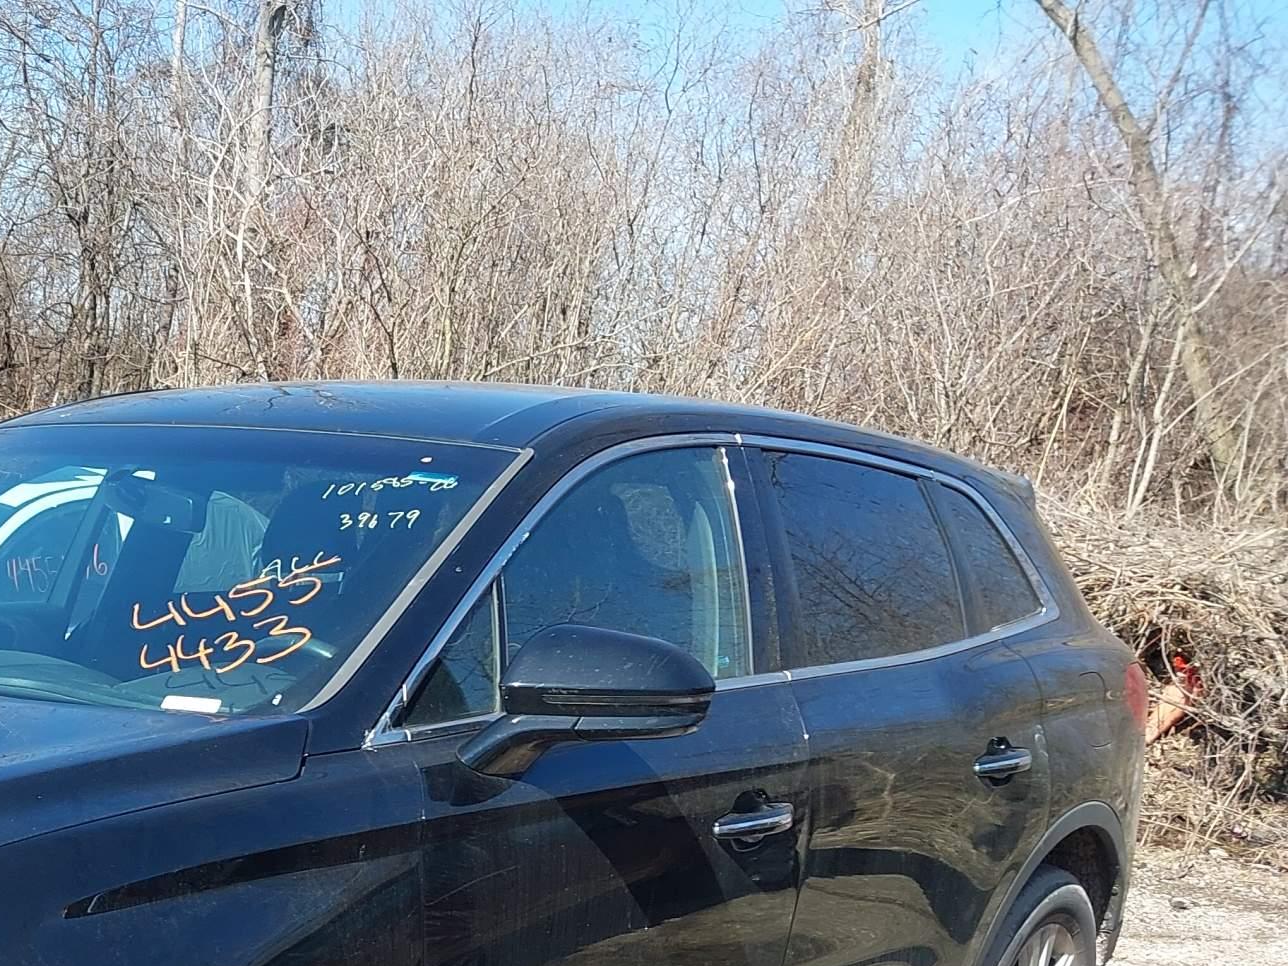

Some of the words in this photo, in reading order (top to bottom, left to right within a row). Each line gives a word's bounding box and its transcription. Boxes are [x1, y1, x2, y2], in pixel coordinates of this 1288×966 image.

[339, 509, 421, 530] 39679
[130, 556, 341, 629] 4455
[139, 615, 312, 673] 4433
